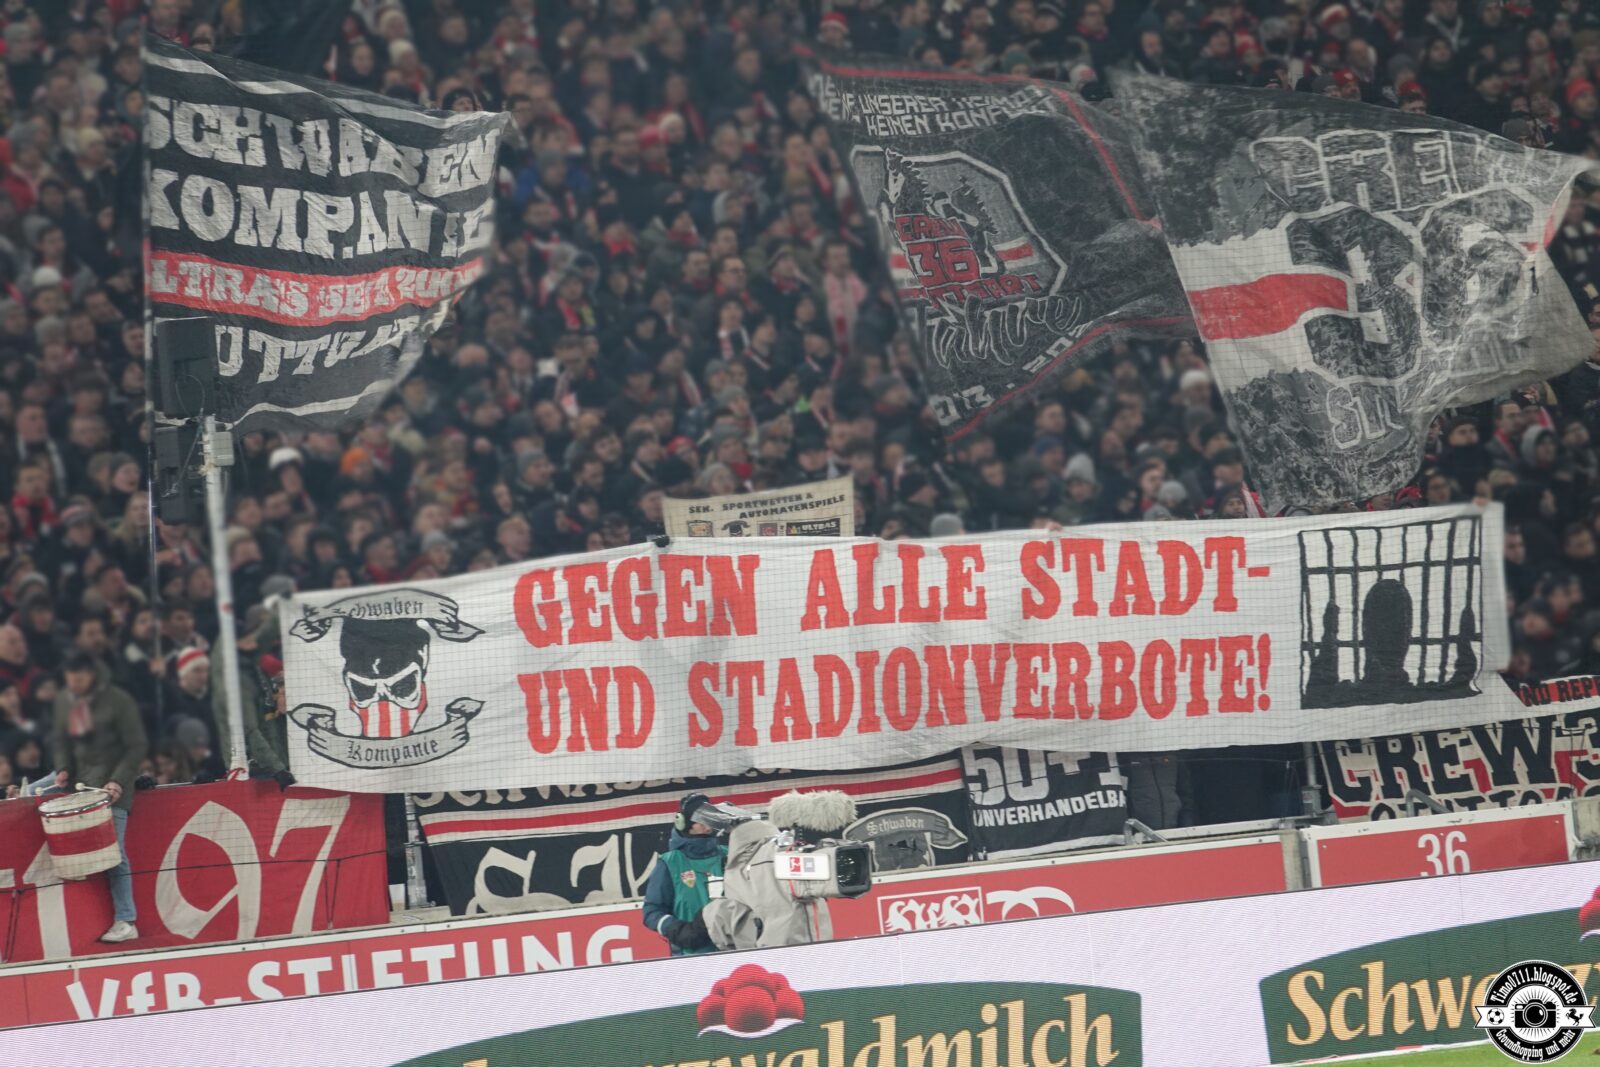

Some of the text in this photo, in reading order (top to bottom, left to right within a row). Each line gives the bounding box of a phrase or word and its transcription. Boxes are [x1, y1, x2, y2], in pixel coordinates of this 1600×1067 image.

[867, 113, 930, 136] KEINEN
[906, 238, 982, 289] 36
[150, 258, 310, 318] LTRAS
[738, 493, 846, 520] AUTOMATENSPIELE
[331, 596, 425, 618] chwaben
[513, 535, 1271, 649] GEGEN ALLE STADT-
[517, 632, 1272, 754] UND STADIONVERBOTE!
[346, 738, 439, 764] Kompanie
[1316, 715, 1559, 807] CREW
[866, 816, 925, 837] Schwaben
[973, 788, 1127, 828] UNVERHANDELBA
[1417, 830, 1471, 878] 36
